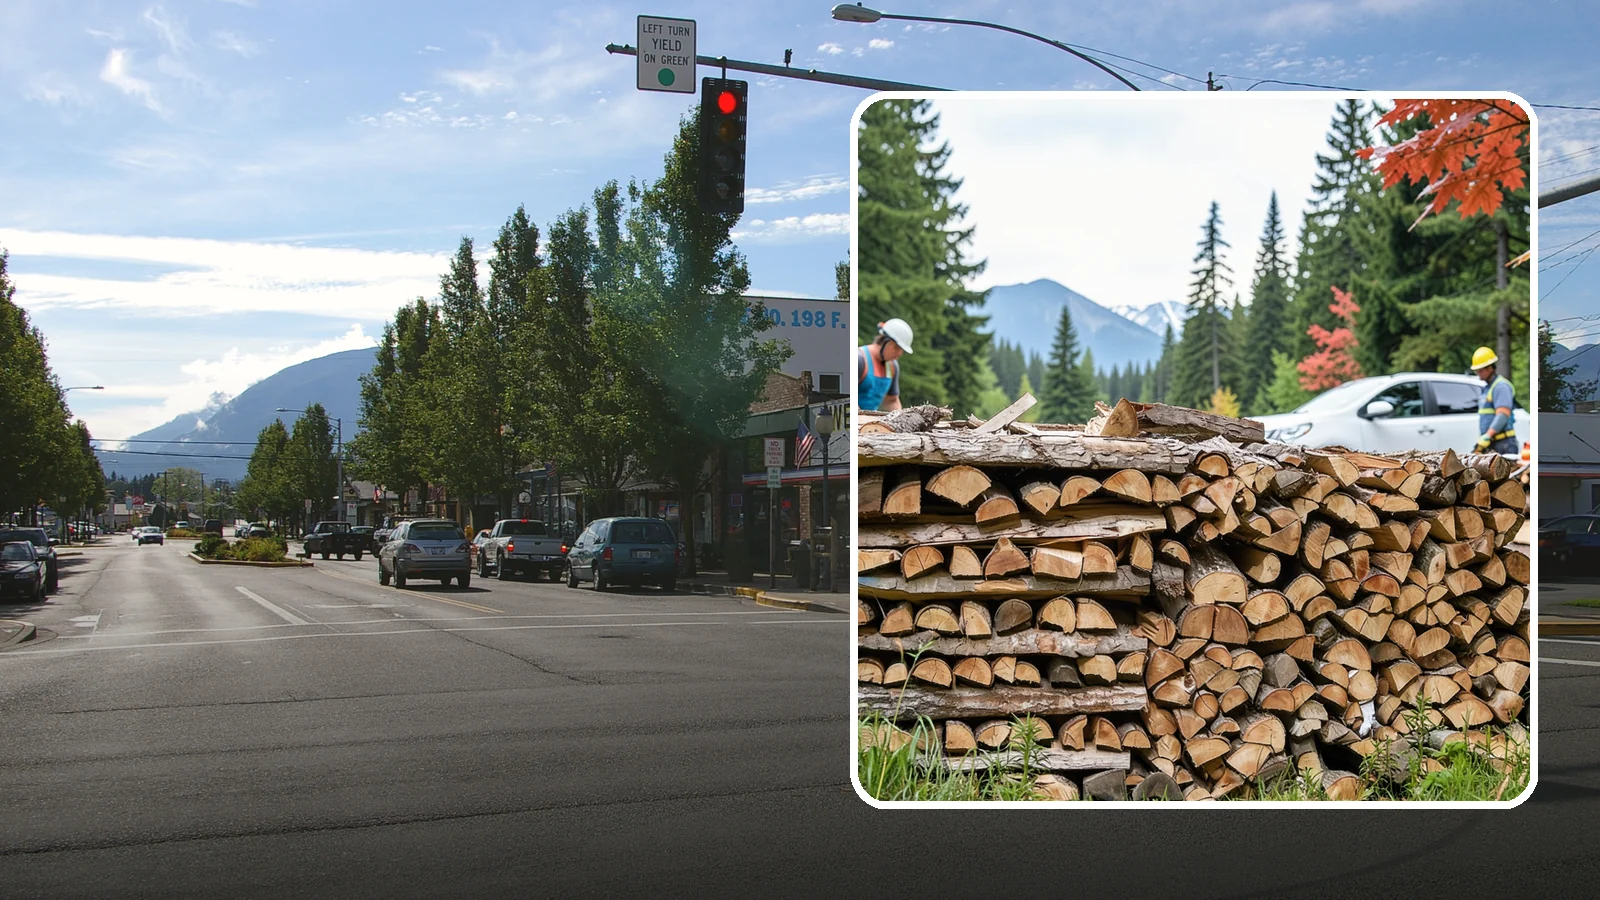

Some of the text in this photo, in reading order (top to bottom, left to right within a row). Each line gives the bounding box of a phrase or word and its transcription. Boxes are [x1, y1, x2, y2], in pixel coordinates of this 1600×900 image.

[642, 23, 690, 37] LEFT TURN
[652, 38, 682, 52] YIELD
[644, 53, 689, 66] ON GREEN
[755, 307, 786, 327] O.
[791, 309, 826, 328] 198
[831, 311, 846, 329] F.
